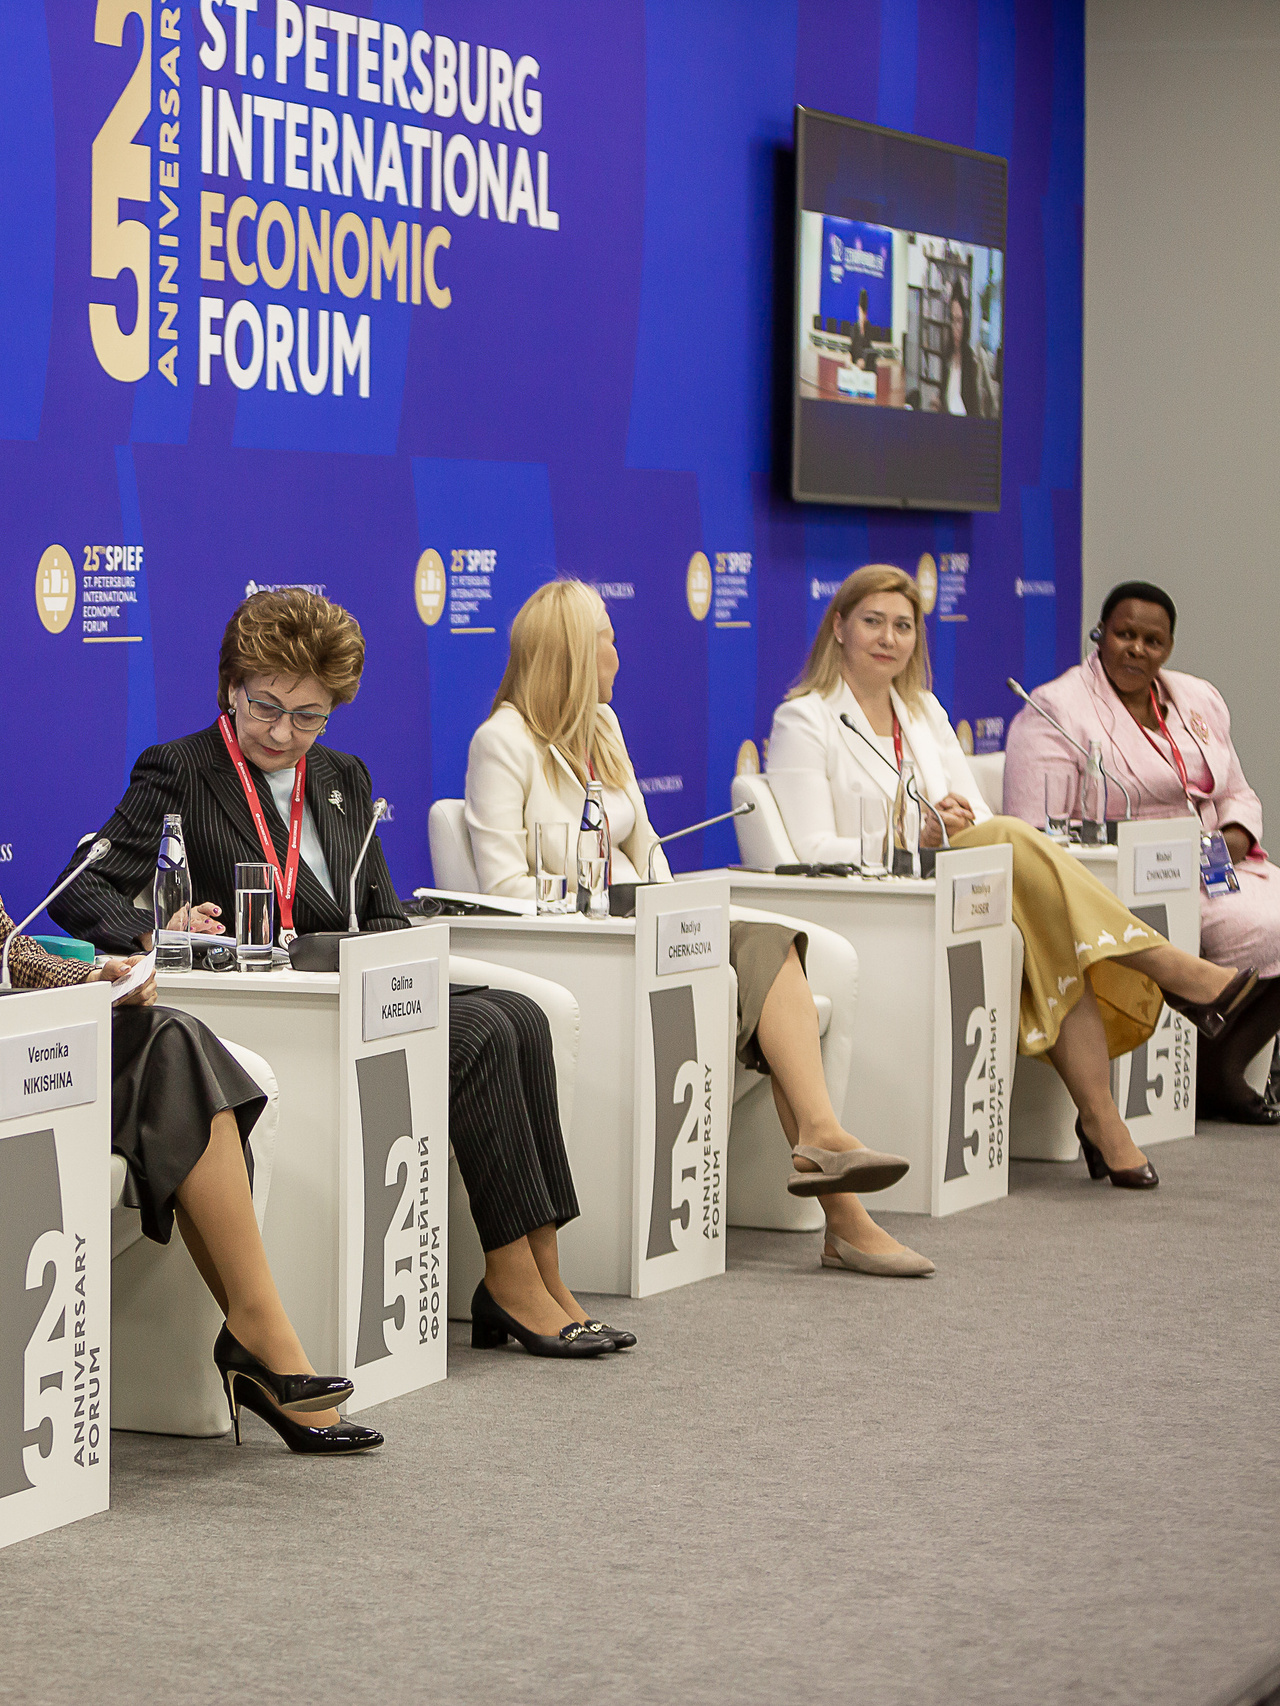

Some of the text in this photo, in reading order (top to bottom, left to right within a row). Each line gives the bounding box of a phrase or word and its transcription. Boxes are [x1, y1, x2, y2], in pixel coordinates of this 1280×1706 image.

[199, 0, 543, 136] ST. PETERSBURG
[158, 0, 182, 387] ANNIVERSAR
[200, 86, 560, 231] INTERNATIONAL
[200, 190, 452, 310] ECONOMIC
[199, 296, 371, 399] FORUM
[105, 545, 144, 572] SPIEF
[83, 605, 120, 618] ECONOMIC
[83, 620, 108, 633] FORUM
[390, 975, 413, 991] Galina
[668, 941, 712, 958] CHERKASOVA
[28, 1042, 70, 1065] Veronika
[381, 999, 422, 1019] KARELOVA
[23, 1072, 74, 1096] NIKISHINA
[988, 1007, 998, 1169] ЮБИЛЕЙНЫЙ
[1174, 1011, 1182, 1111] ЮБИЛЕЙ
[702, 1064, 713, 1240] ANNIVERSARY
[712, 1149, 720, 1239] FORUM
[417, 1135, 430, 1345] ЮБИЛЕЙНЫЙ
[431, 1225, 441, 1341] ФОРУМ
[73, 1233, 87, 1468] ANNIVERSARY
[89, 1346, 101, 1466] FORUM
